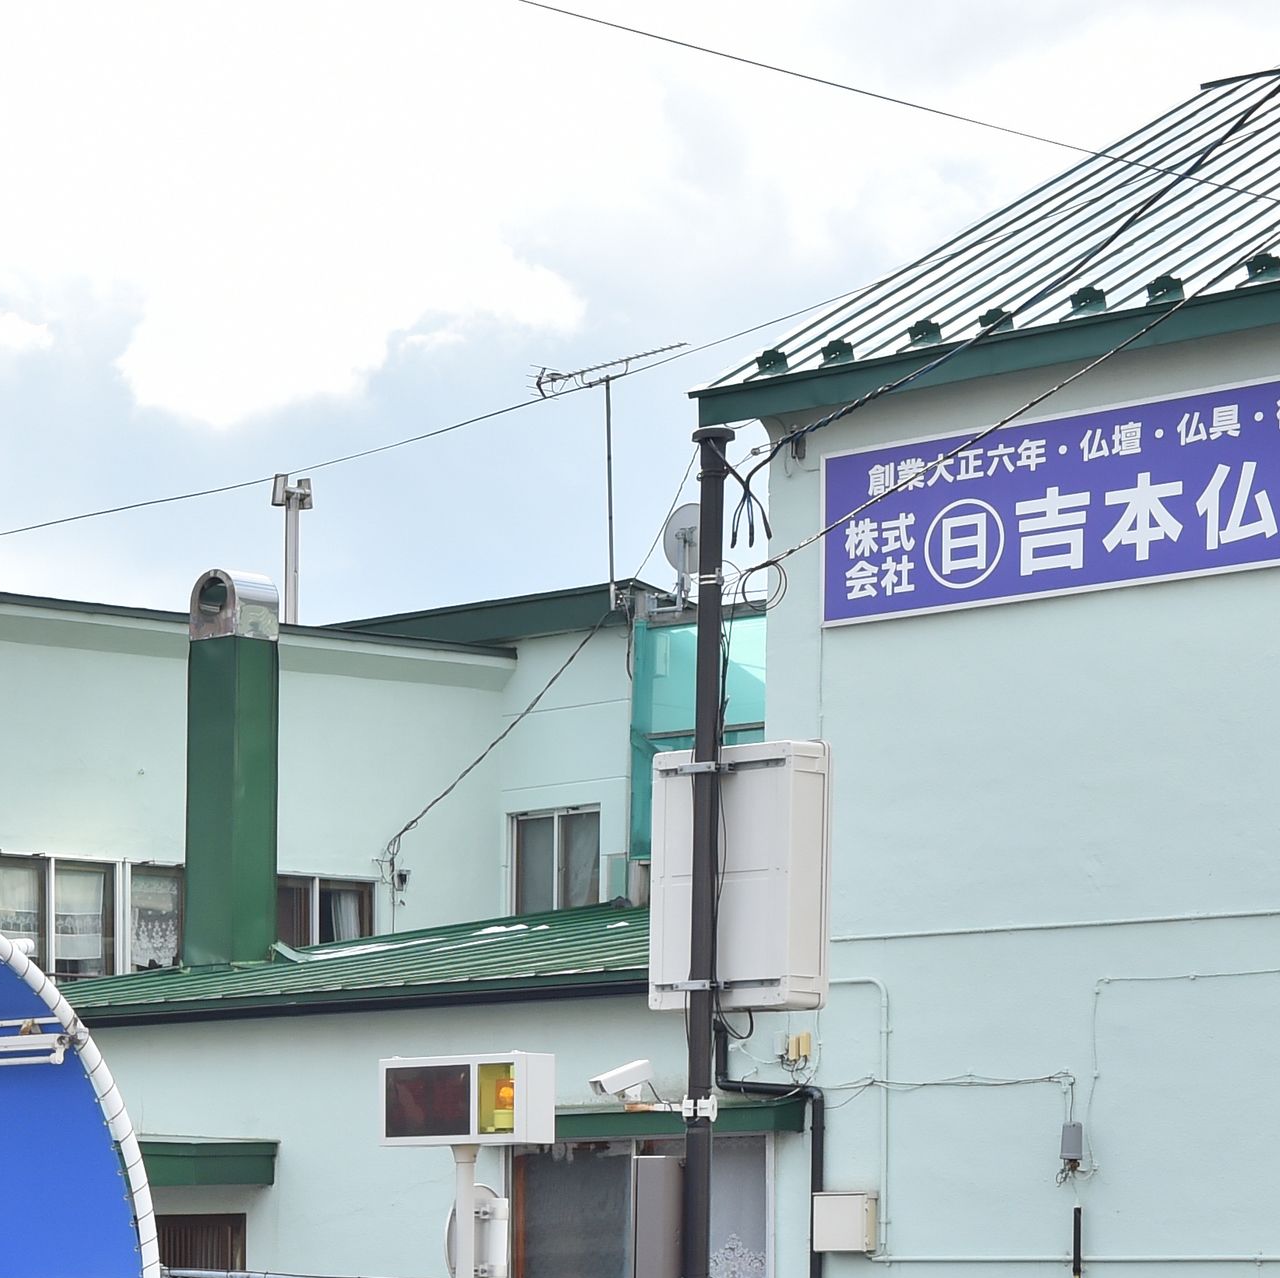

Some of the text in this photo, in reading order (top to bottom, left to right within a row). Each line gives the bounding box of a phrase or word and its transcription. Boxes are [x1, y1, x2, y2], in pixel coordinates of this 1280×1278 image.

[844, 512, 916, 560] 株式
[1014, 461, 1279, 577] 吉本仏
[844, 554, 916, 600] 会社
